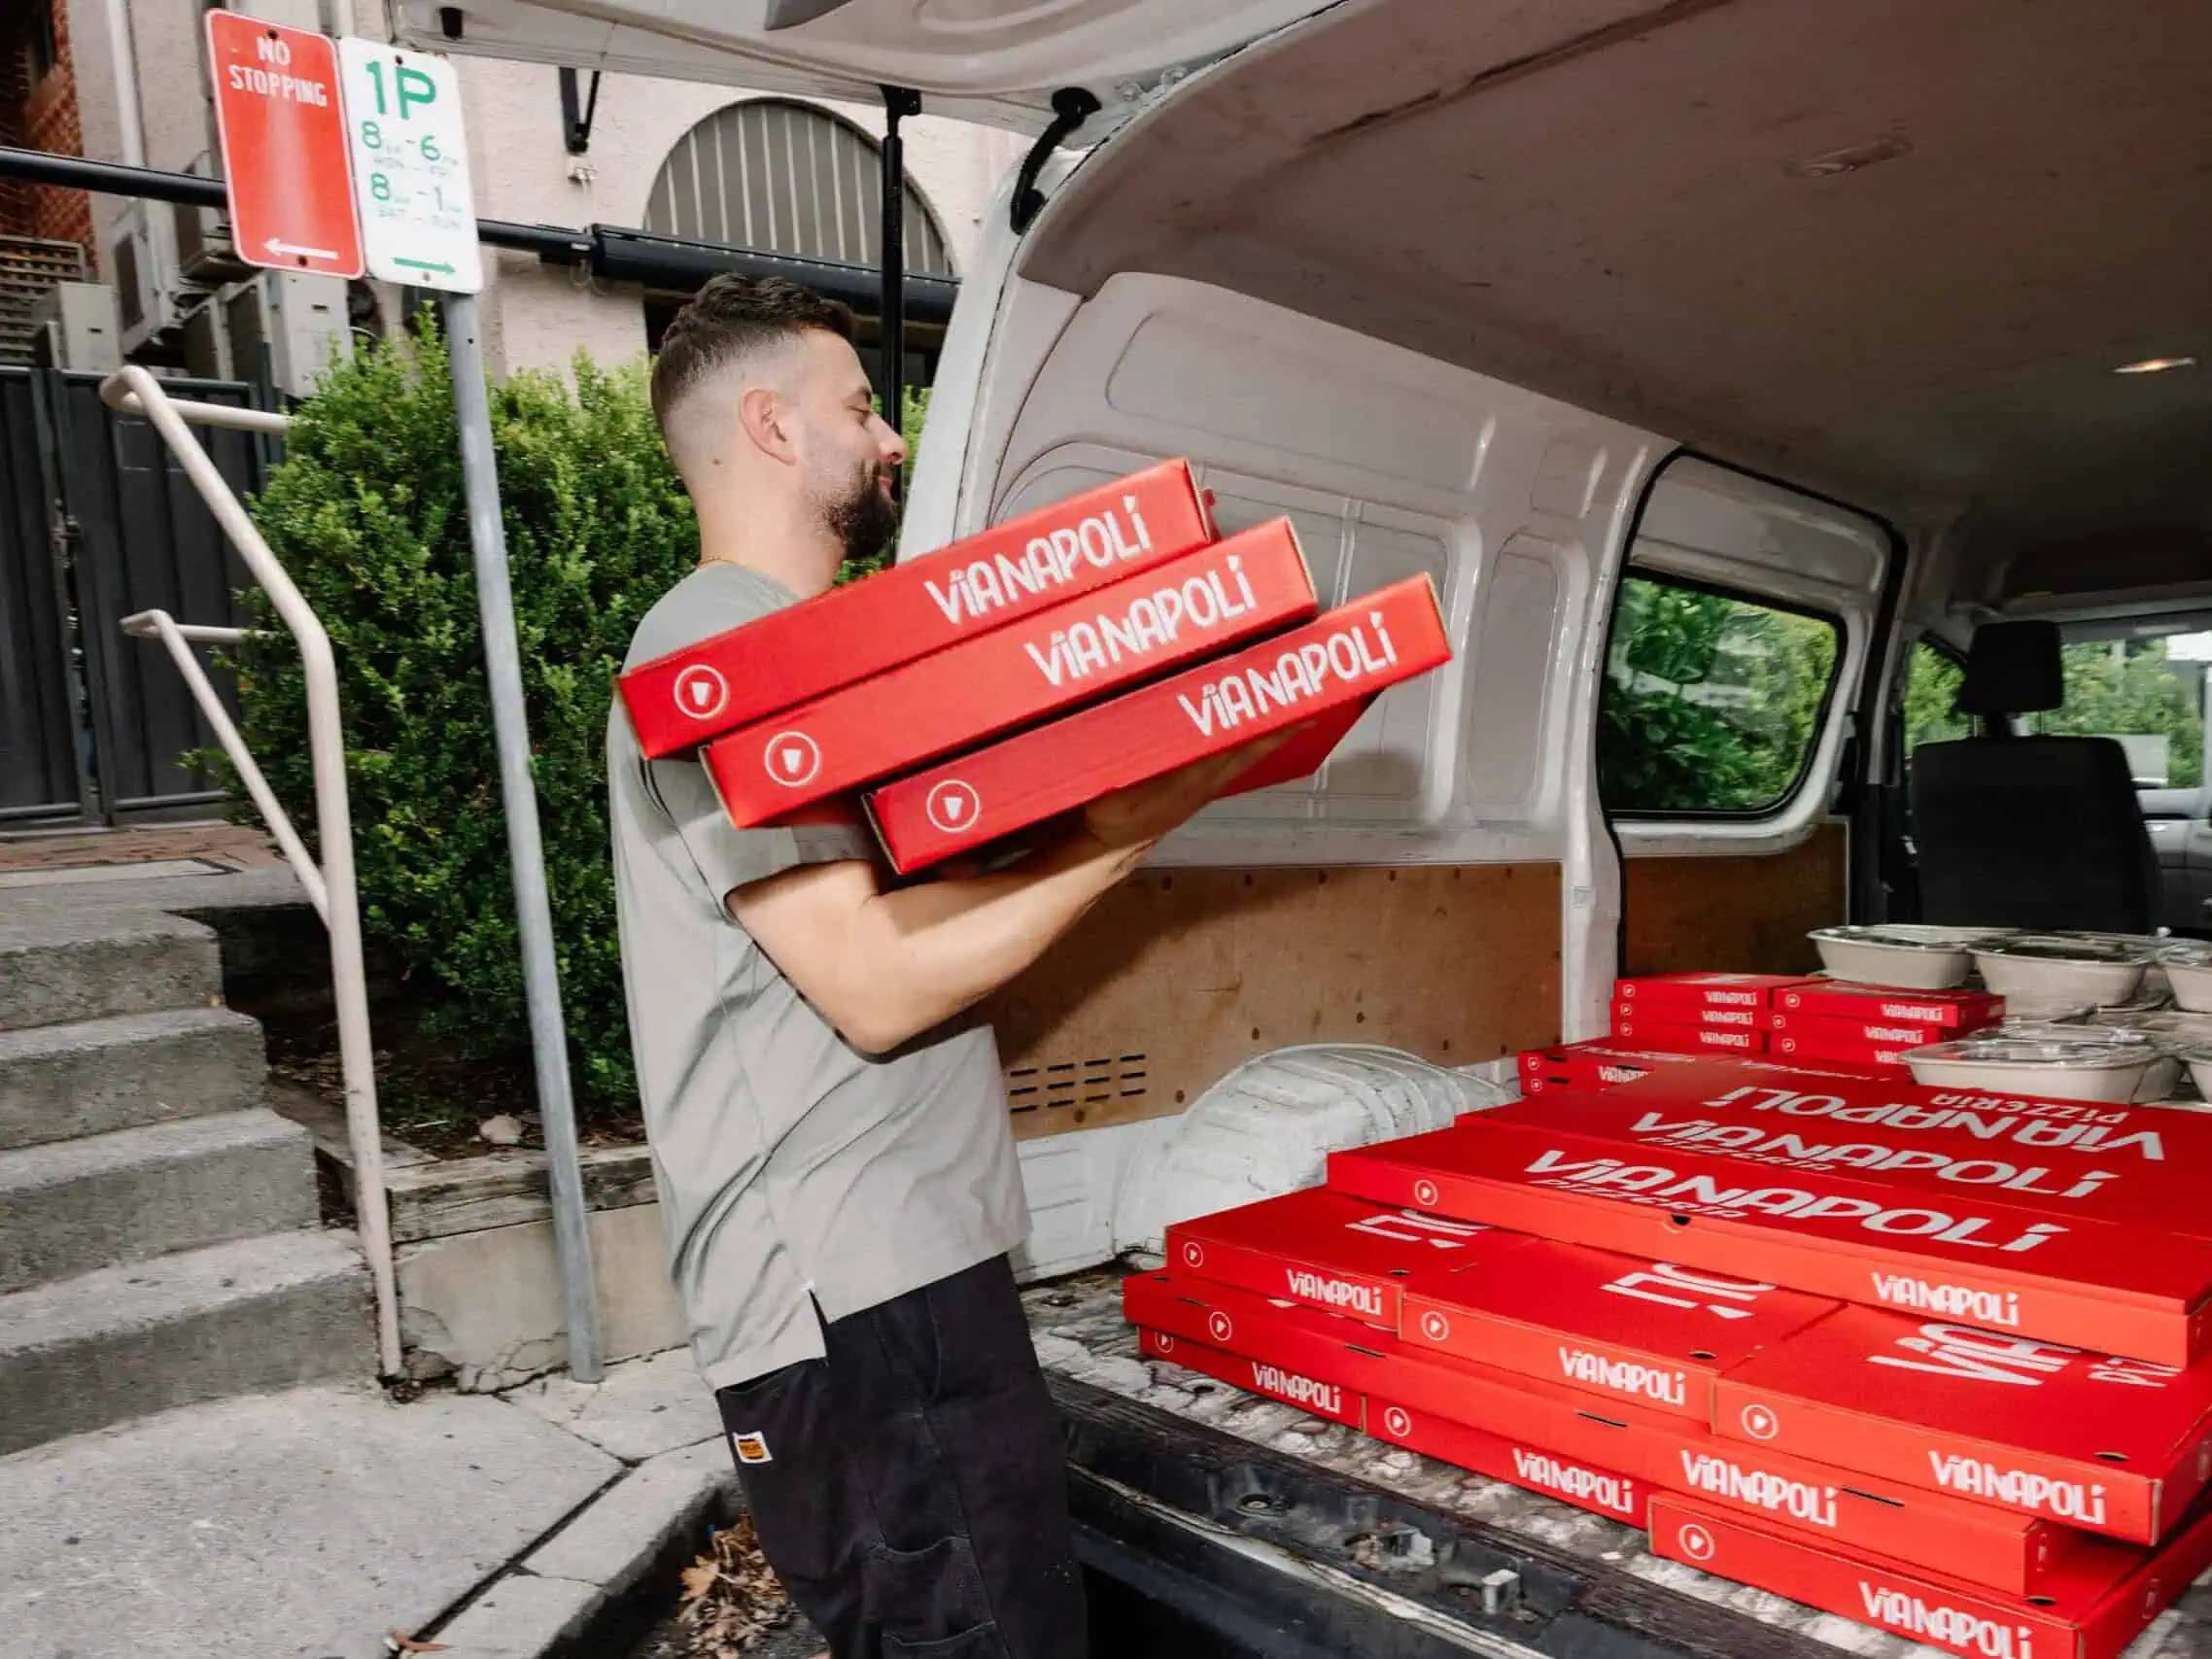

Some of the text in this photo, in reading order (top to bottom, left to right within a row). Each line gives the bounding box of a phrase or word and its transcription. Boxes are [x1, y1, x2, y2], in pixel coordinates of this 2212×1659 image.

[257, 37, 291, 65] NO
[228, 64, 328, 107] STOPPING
[365, 60, 436, 121] 1P
